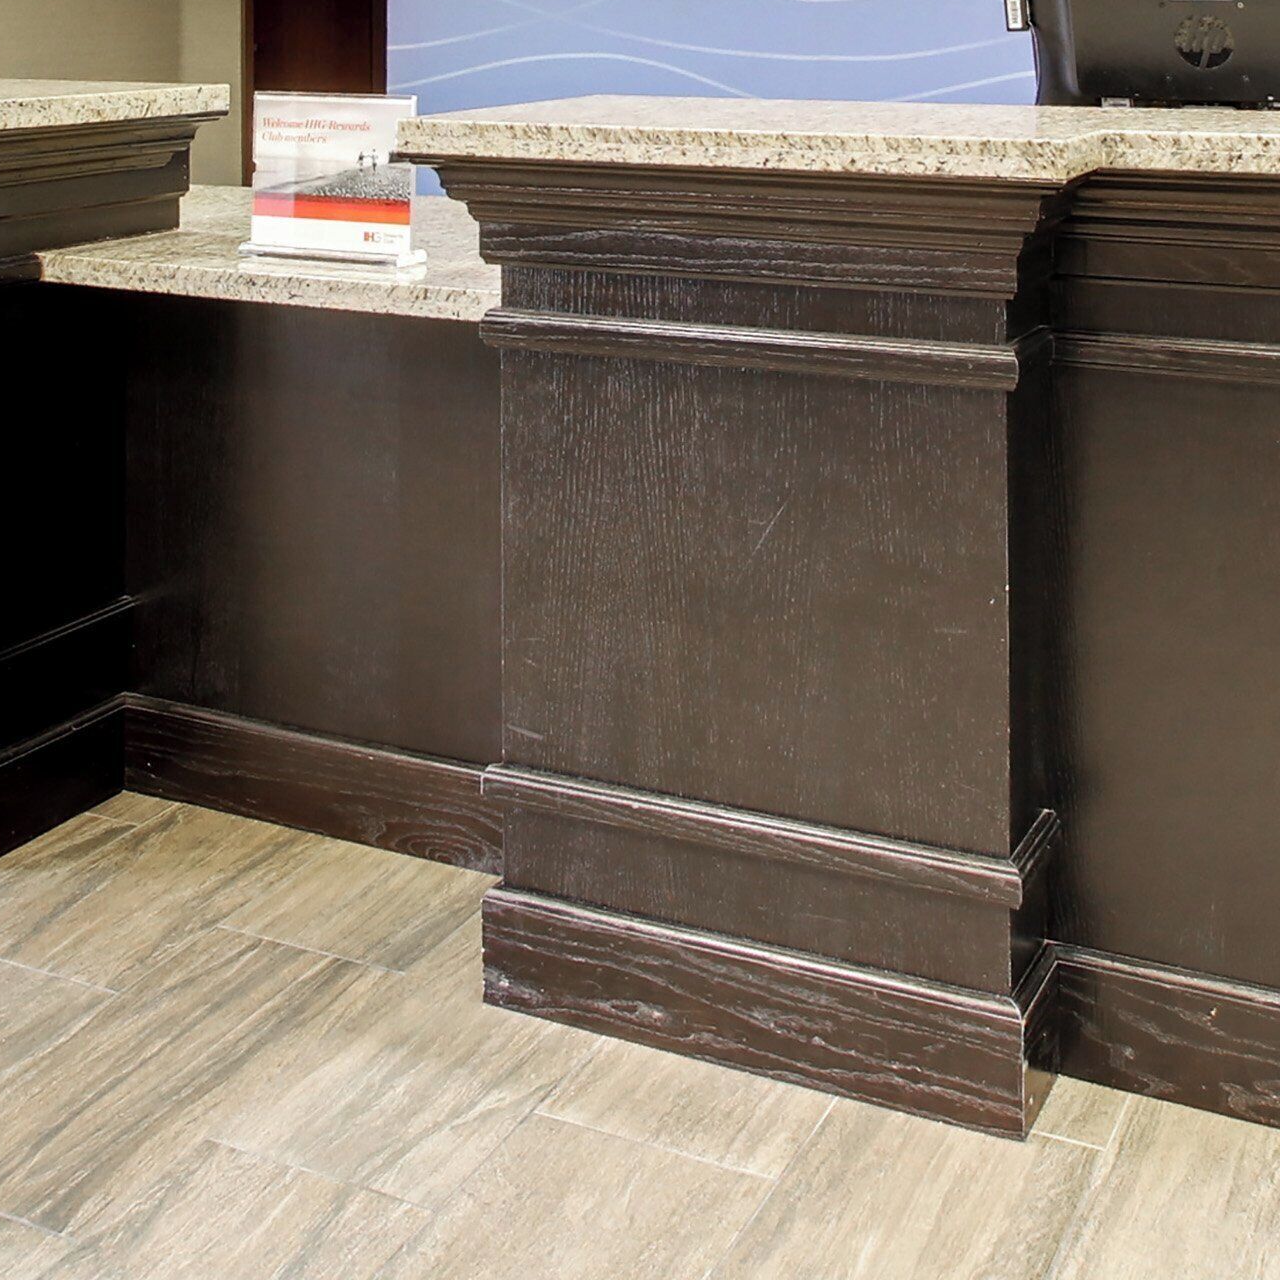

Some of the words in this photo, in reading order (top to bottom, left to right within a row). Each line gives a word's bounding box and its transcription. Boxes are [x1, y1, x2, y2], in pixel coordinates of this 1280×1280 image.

[262, 117, 304, 129] Welcome
[329, 120, 372, 132] Rewards
[262, 131, 283, 142] Club
